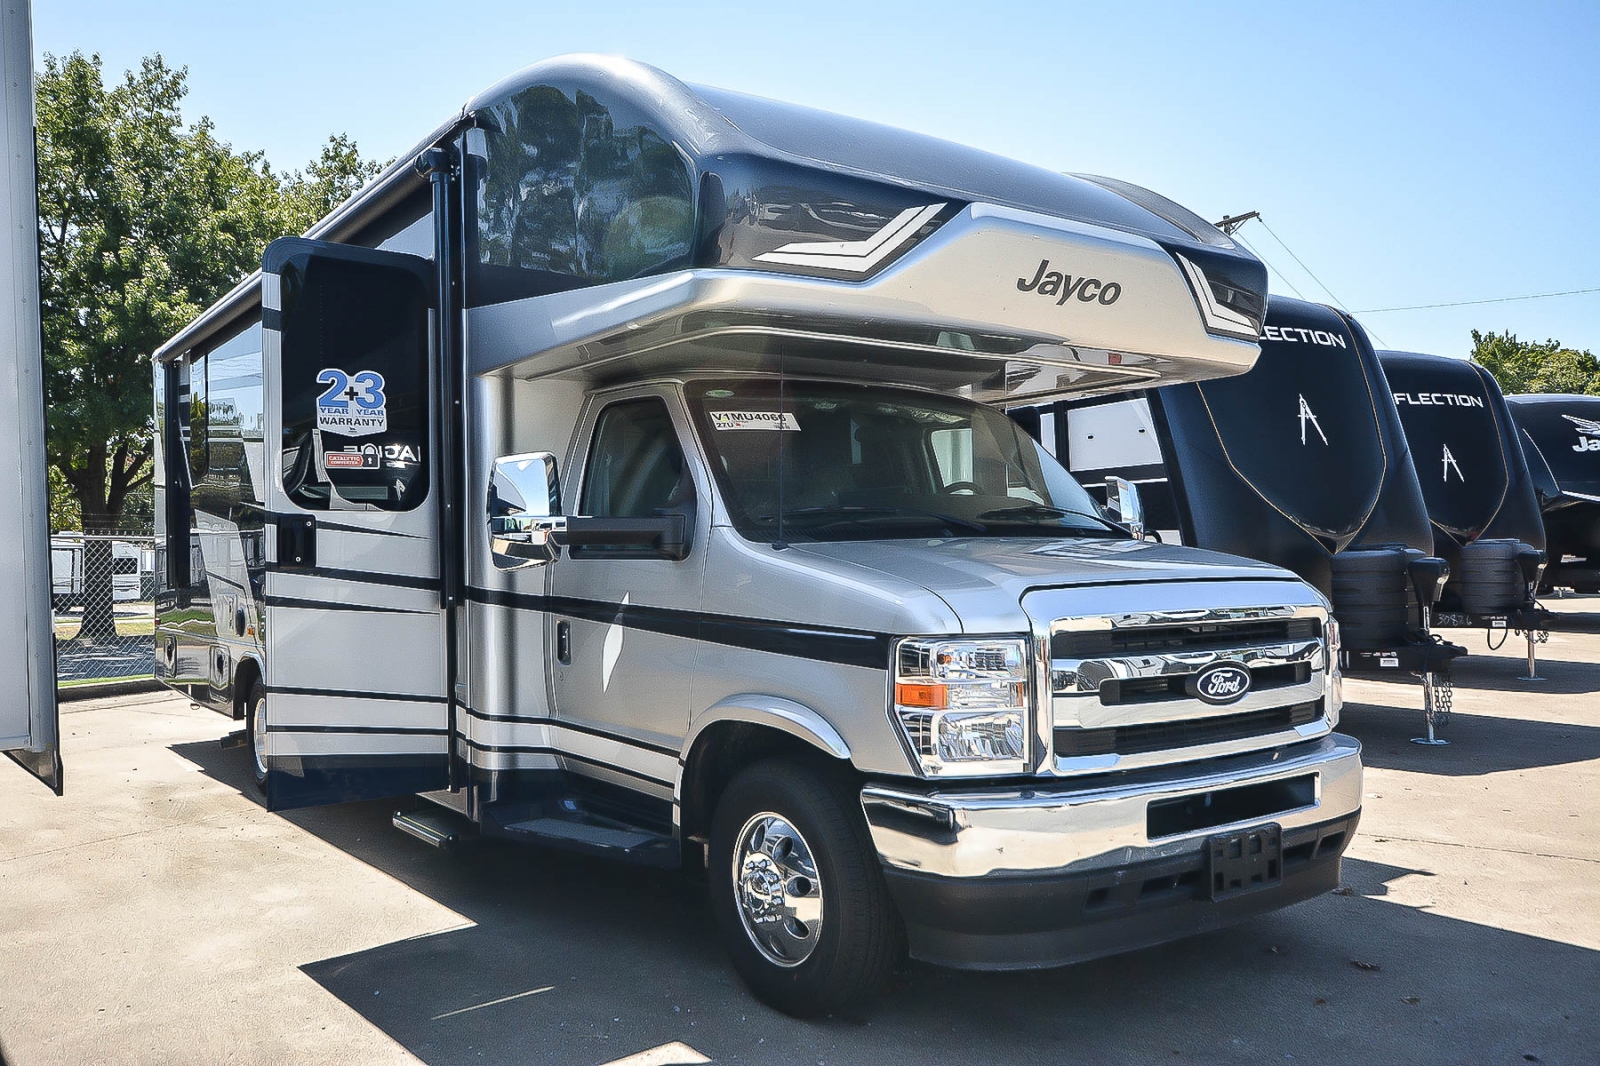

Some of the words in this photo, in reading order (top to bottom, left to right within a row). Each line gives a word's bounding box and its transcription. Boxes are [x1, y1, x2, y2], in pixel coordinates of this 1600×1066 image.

[1017, 259, 1122, 306] Jayco
[1393, 393, 1484, 408] FLECTION
[320, 417, 384, 426] WARRANTY
[1208, 672, 1241, 695] Ford
